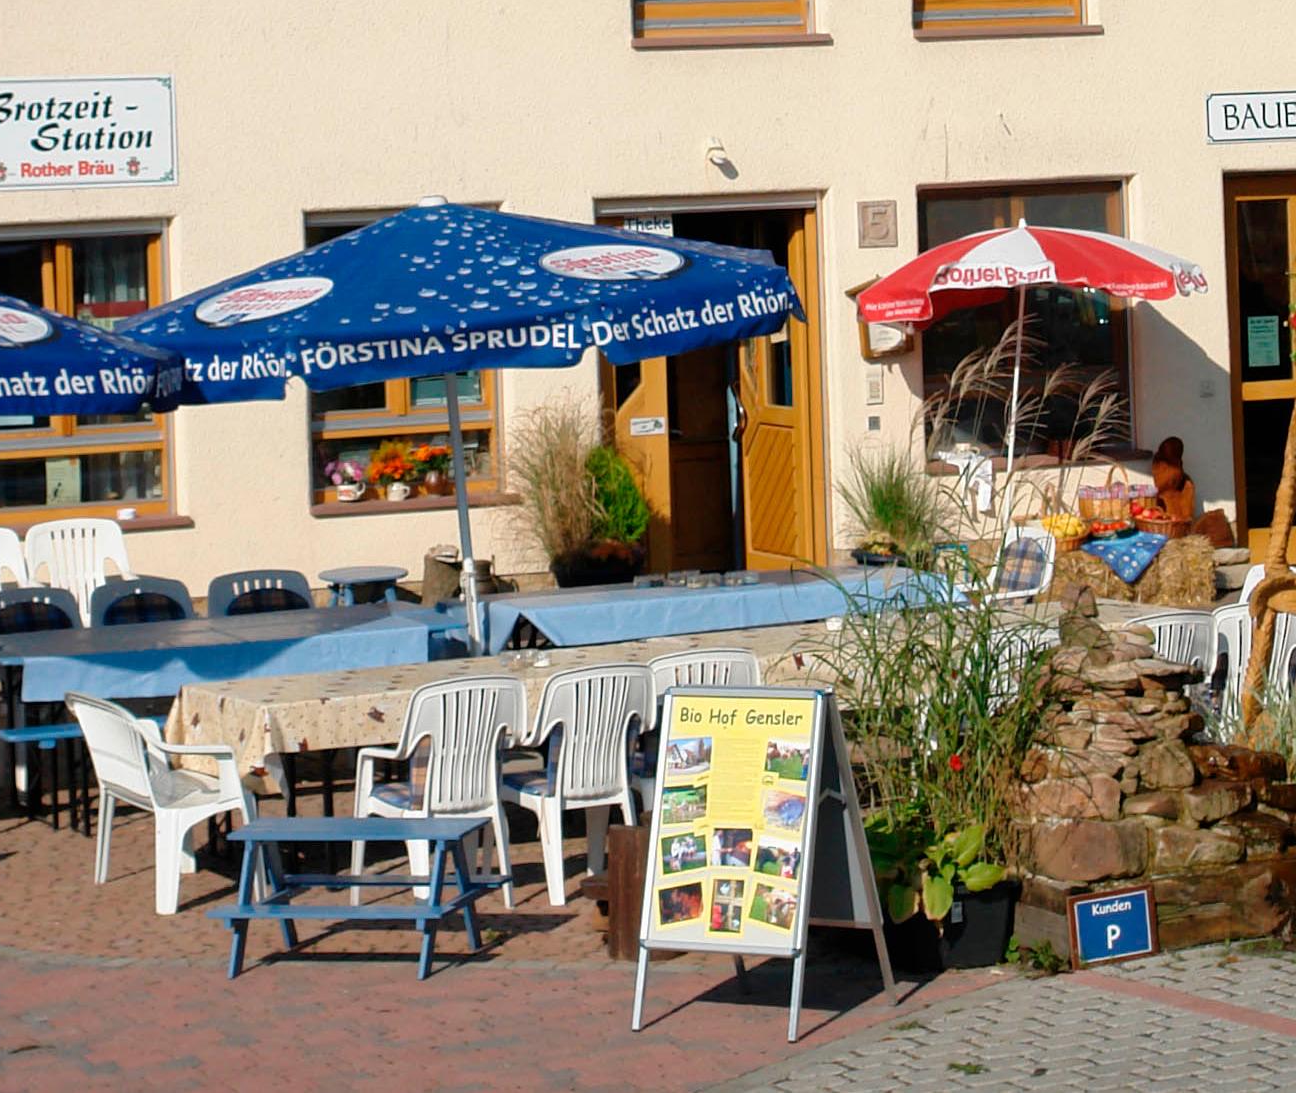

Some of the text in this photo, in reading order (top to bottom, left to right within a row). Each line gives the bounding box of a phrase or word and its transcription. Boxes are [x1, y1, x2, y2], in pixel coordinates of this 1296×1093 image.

[30, 122, 153, 152] Station
[20, 160, 115, 178] Rother Bräu
[624, 216, 671, 231] Theke
[868, 208, 890, 241] 5
[591, 320, 631, 347] Der
[631, 307, 700, 340] Schatz
[701, 299, 735, 326] der
[301, 323, 582, 375] FÖRSTINA SPRUDEL
[207, 354, 239, 381] der
[54, 368, 96, 396] der
[680, 707, 803, 726] Bio Hof Gensler
[1091, 900, 1132, 917] Kunden
[1106, 924, 1121, 950] P
